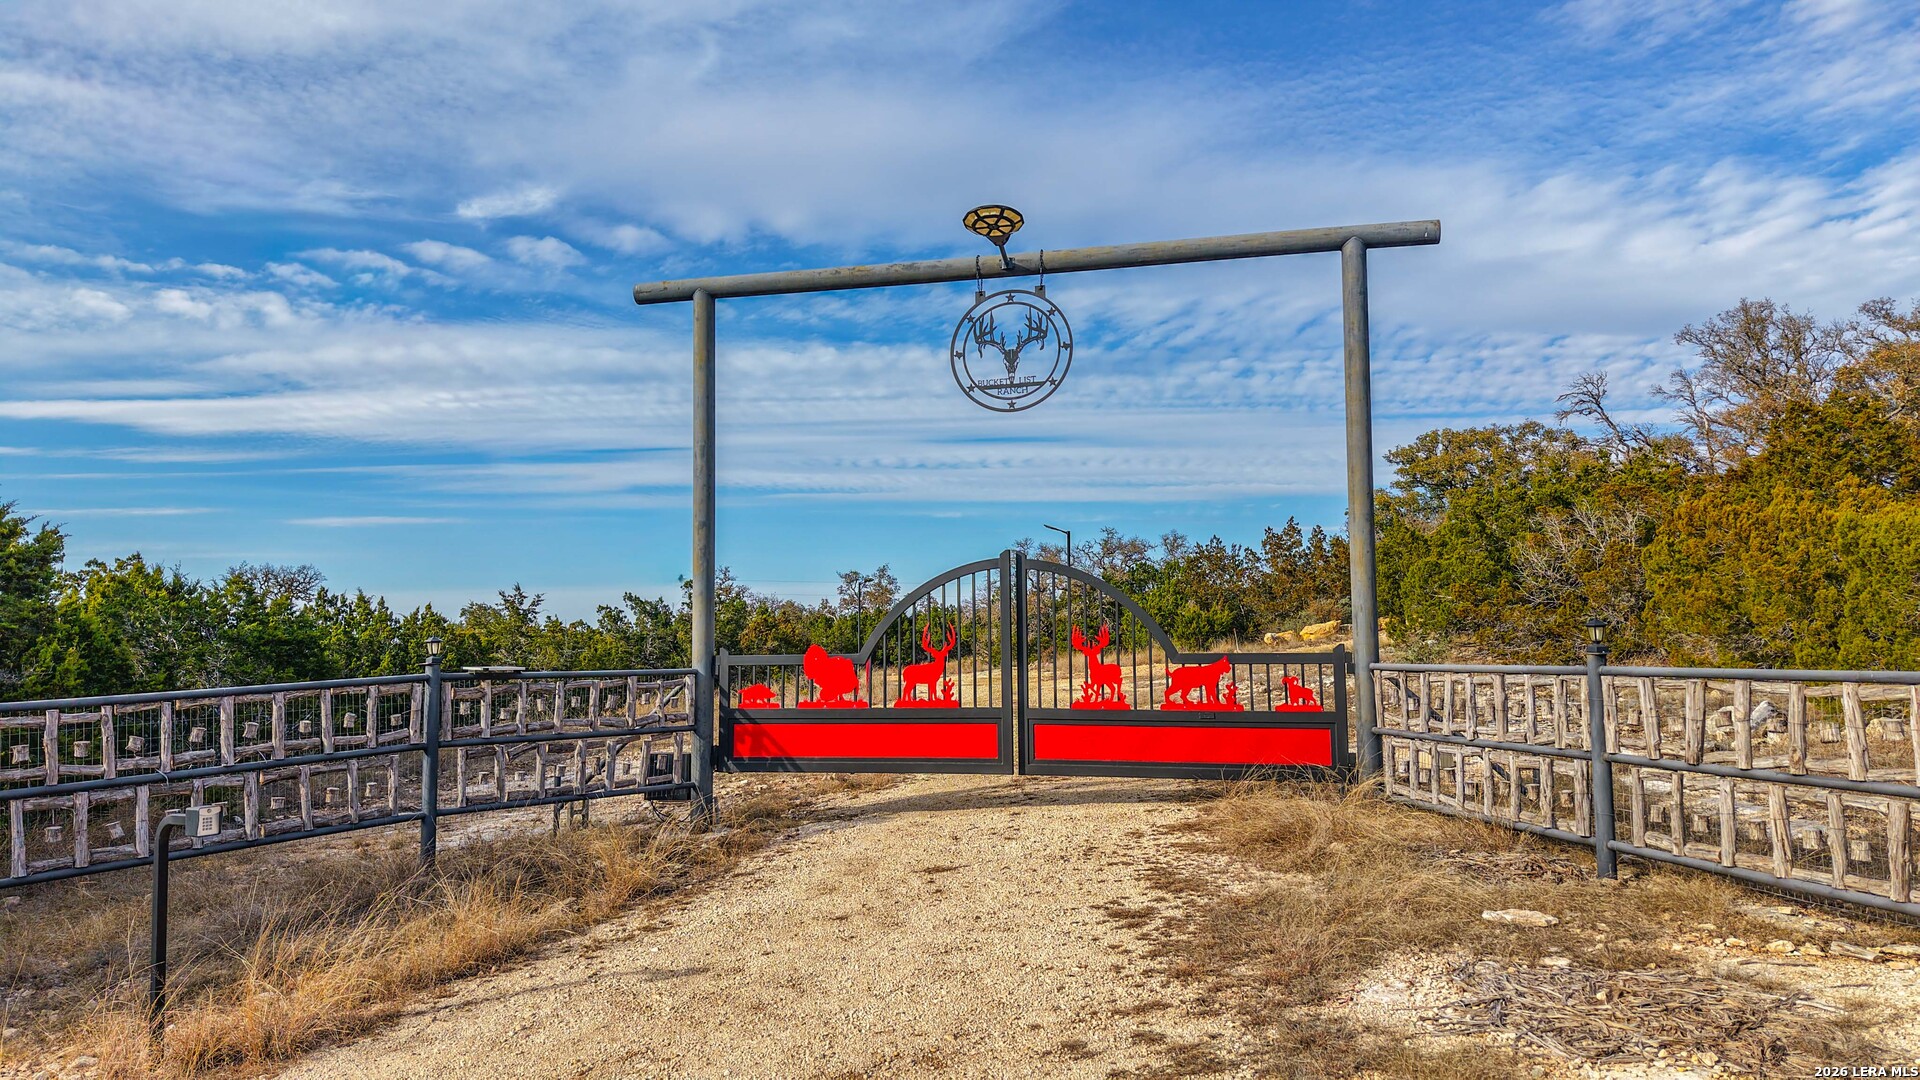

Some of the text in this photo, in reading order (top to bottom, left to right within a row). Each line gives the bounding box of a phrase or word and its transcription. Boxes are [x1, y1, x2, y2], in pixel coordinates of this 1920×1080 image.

[977, 375, 1036, 387] BUCKET LIST
[997, 386, 1028, 395] RANCH
